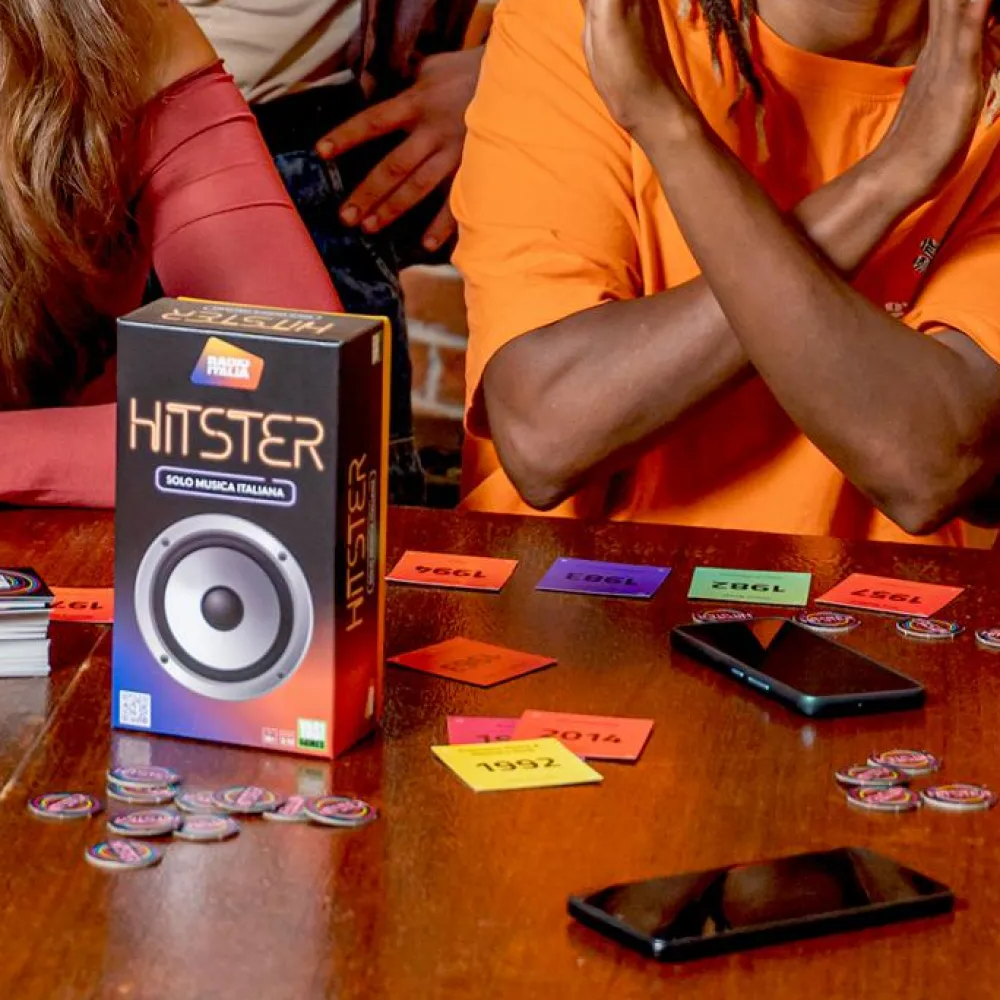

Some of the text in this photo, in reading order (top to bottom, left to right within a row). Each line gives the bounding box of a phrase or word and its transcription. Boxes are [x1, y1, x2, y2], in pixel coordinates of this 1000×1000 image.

[160, 307, 335, 336] HITSTER
[130, 397, 325, 472] HITSTER
[166, 474, 286, 499] SOLO MUSICA ITALIANA
[346, 453, 367, 632] HITSTER
[415, 565, 487, 579] 1994
[711, 581, 787, 593] 1982
[476, 756, 561, 773] 1992
